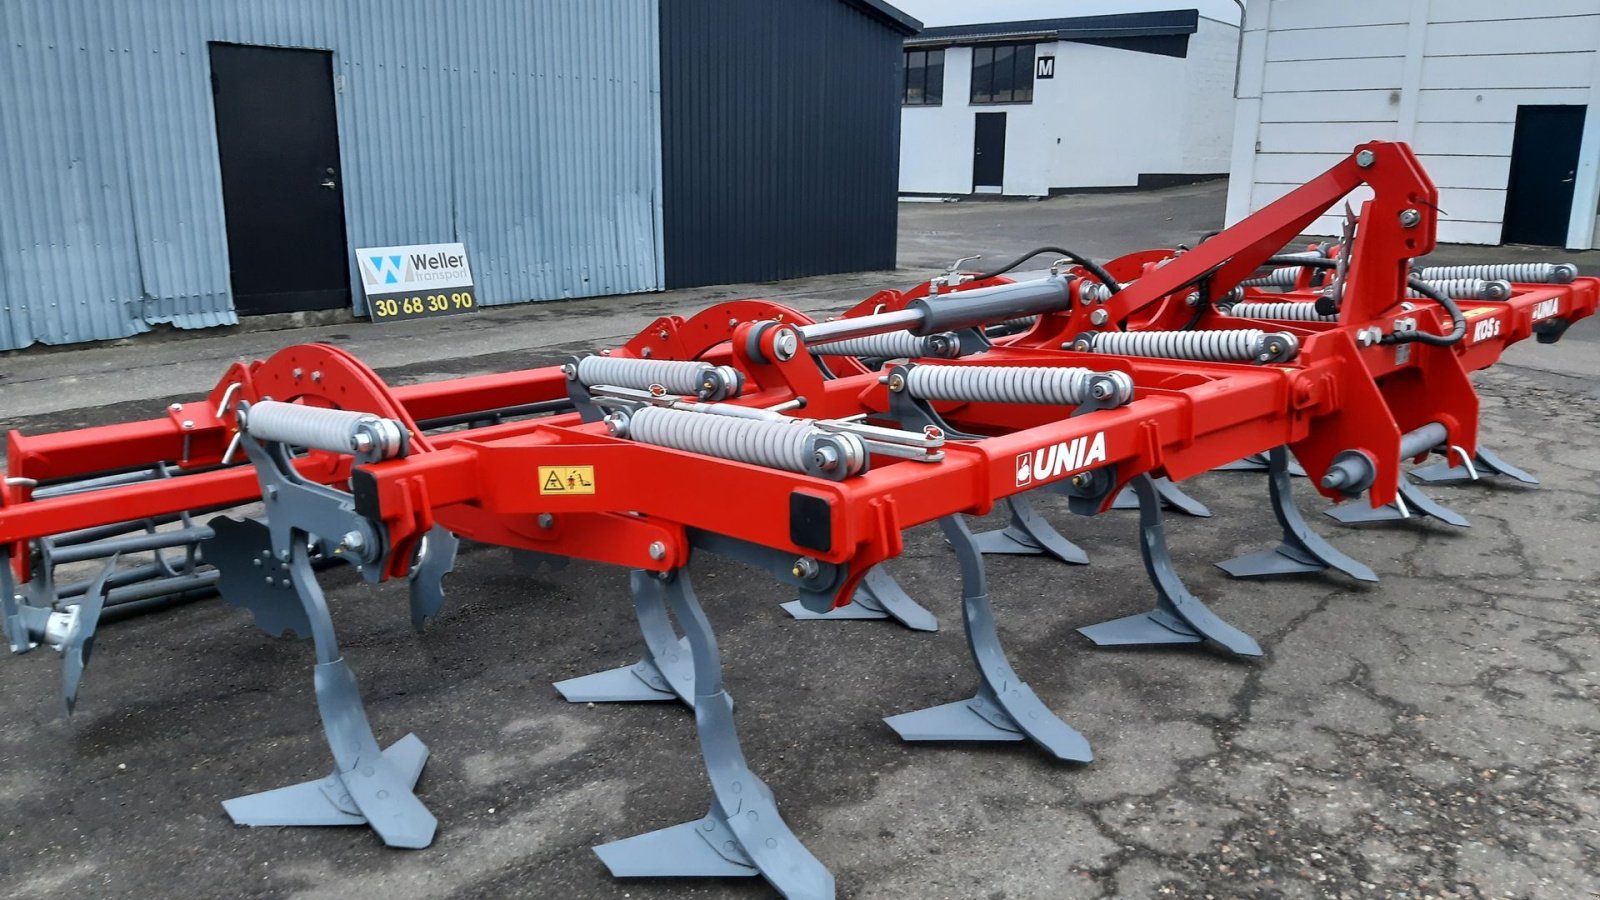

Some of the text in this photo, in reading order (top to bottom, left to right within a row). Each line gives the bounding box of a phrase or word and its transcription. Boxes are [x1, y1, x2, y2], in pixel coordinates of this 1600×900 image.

[1039, 59, 1053, 76] M
[410, 252, 464, 271] Weller
[416, 269, 468, 282] transport
[375, 291, 473, 317] 30 68 30 90
[1033, 431, 1106, 481] UNIA
